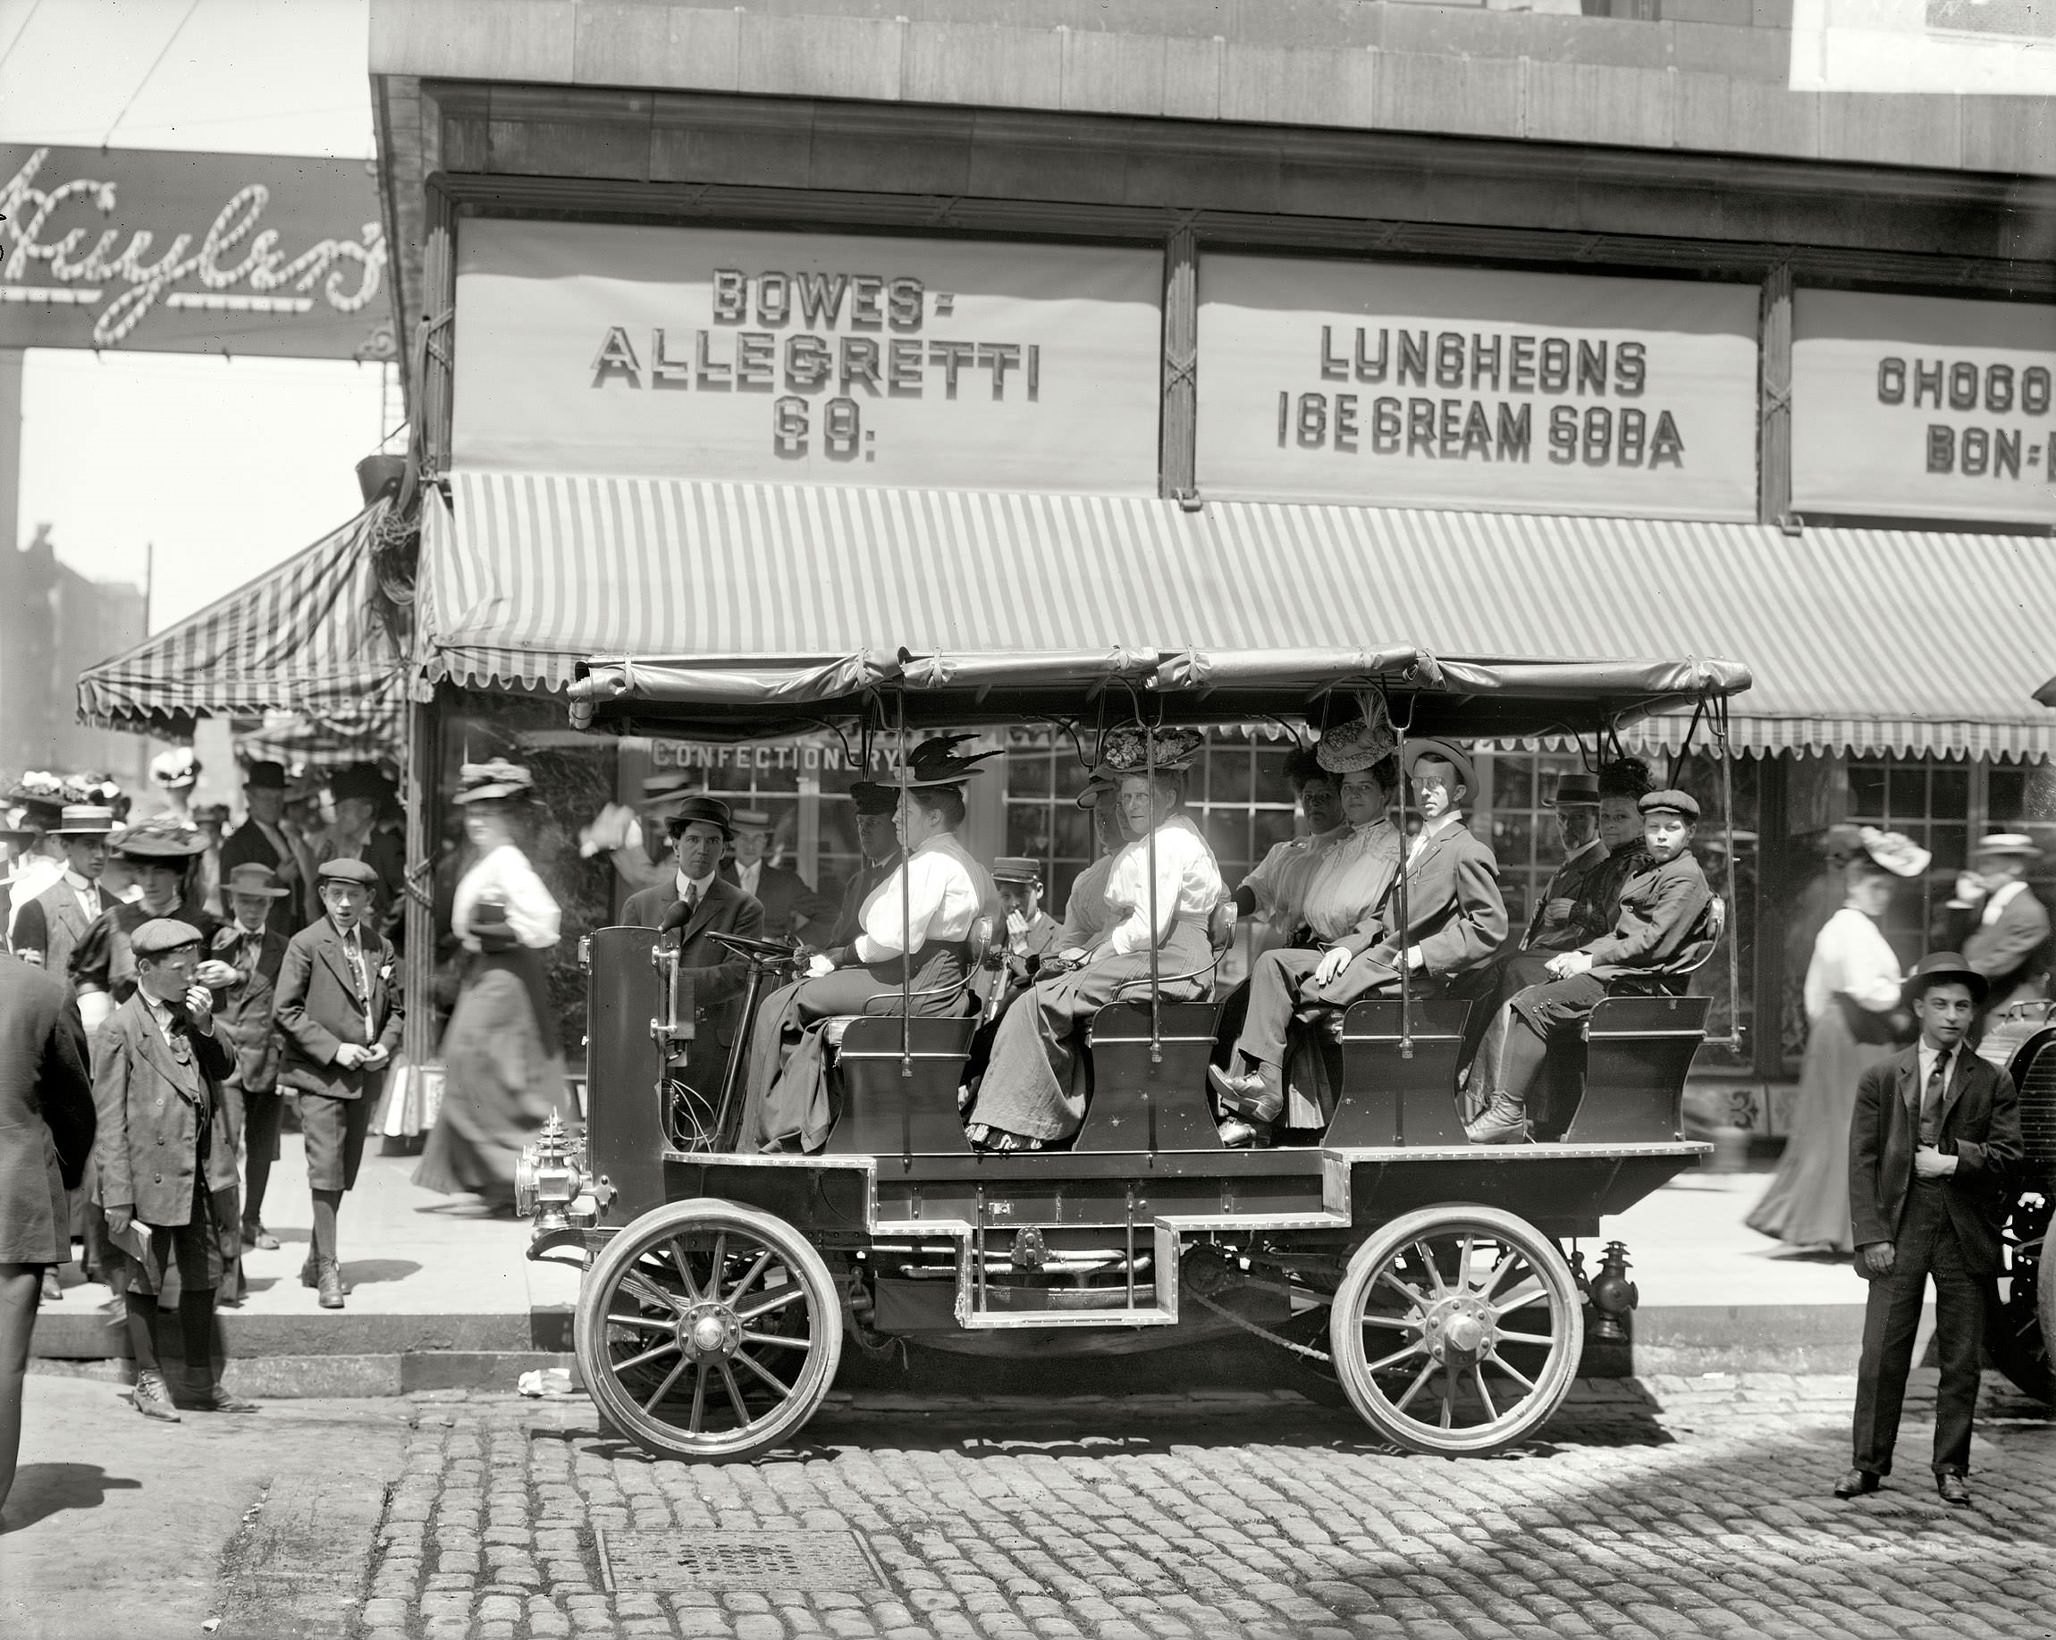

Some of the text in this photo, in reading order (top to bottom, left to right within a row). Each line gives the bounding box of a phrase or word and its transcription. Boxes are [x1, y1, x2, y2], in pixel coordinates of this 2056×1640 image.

[590, 326, 1040, 401] ALLEGRETTI
[1320, 325, 1647, 397] LUNCHEONS
[1277, 391, 1685, 469] ICE CREAM SODA
[1926, 424, 2056, 483] BON-
[652, 739, 899, 772] CONFECTIONERY
